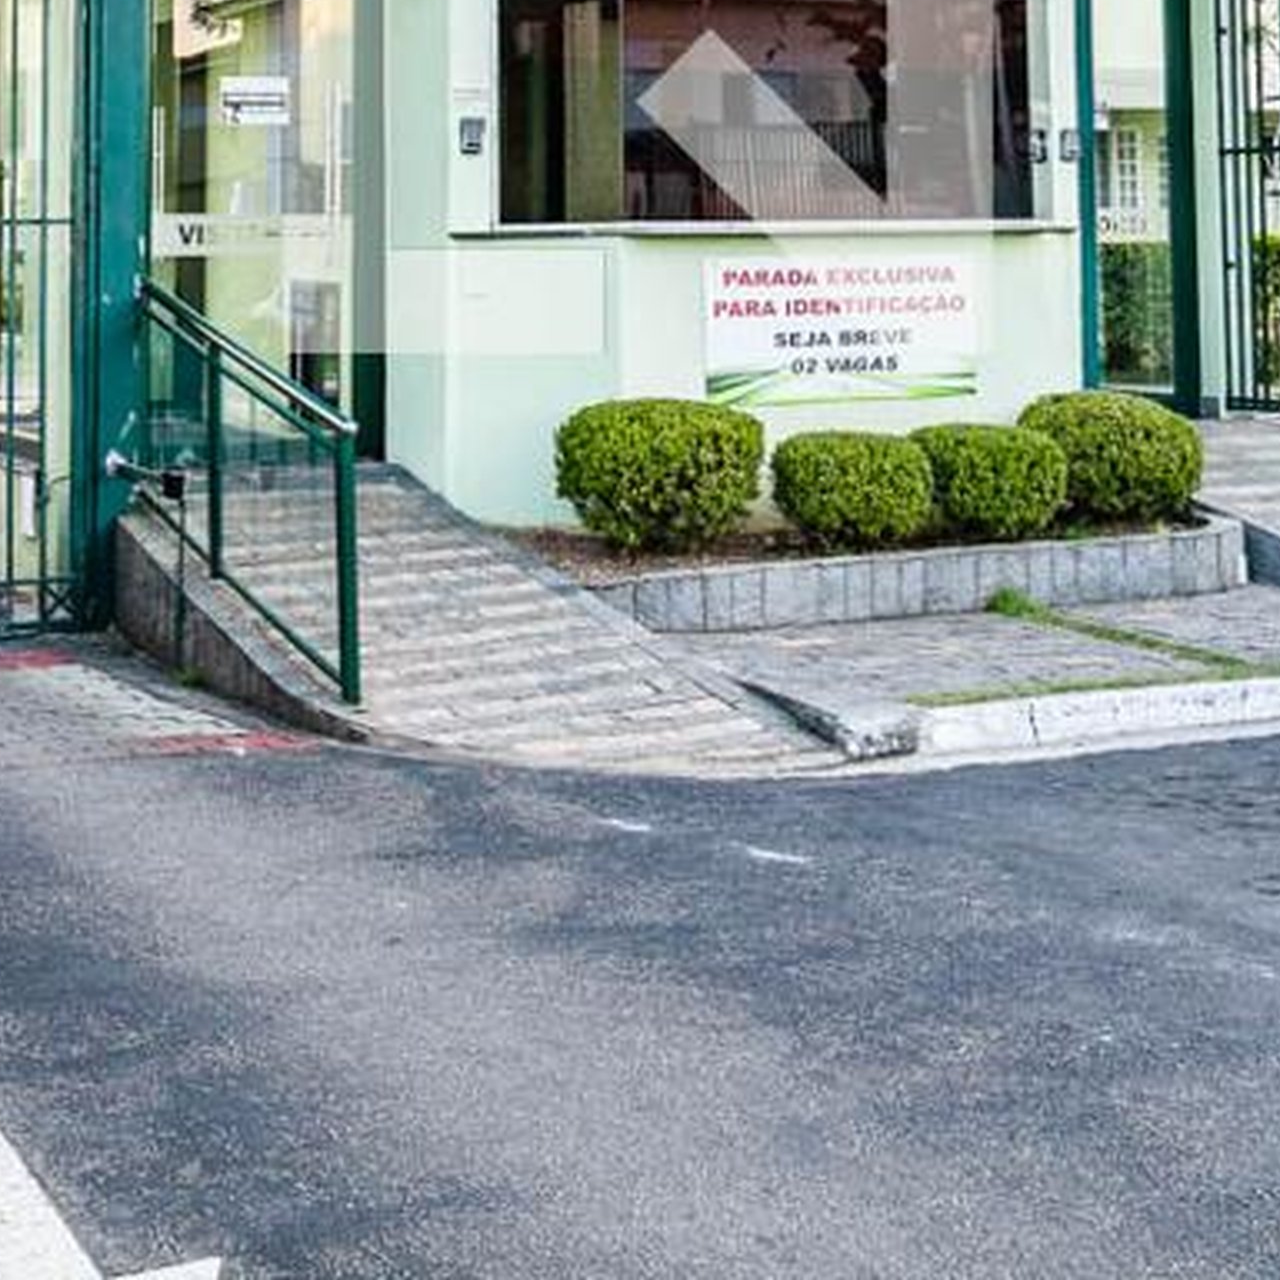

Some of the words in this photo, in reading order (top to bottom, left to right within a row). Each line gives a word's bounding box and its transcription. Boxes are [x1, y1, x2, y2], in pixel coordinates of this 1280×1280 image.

[723, 269, 817, 288] PARADA
[826, 267, 956, 286] EXCLUSIVA
[714, 299, 776, 318] PARA
[785, 294, 966, 317] IDENTIFICAÇÃO
[773, 330, 831, 348] SEJA
[839, 328, 912, 347] BREVE
[792, 357, 818, 375] 02
[826, 355, 898, 374] VAGAS
